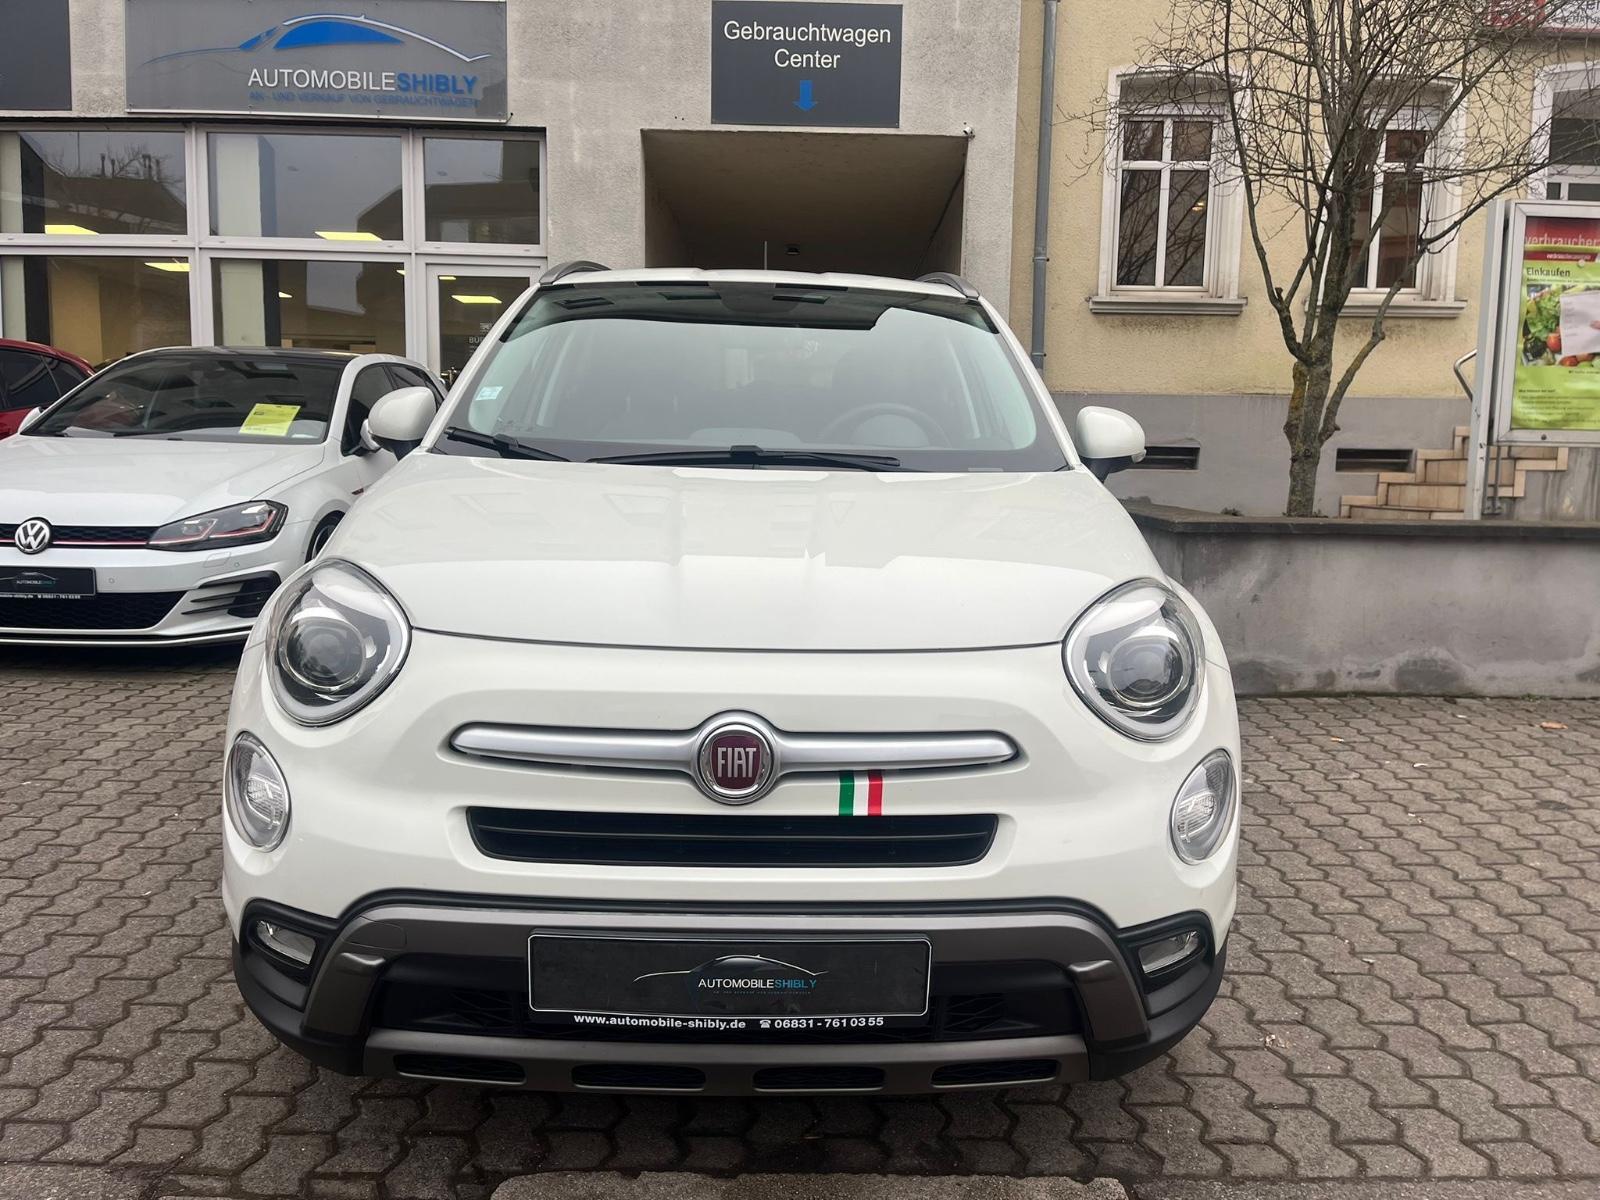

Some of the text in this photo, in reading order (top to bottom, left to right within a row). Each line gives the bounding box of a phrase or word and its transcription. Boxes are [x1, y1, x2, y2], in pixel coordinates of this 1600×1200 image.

[723, 20, 892, 47] Gebrauchtwagen
[774, 48, 841, 68] Center
[247, 68, 479, 95] AUTOMOBILESHIBLY
[1526, 267, 1571, 277] Einkaufen
[717, 747, 757, 778] FIAT
[698, 978, 817, 989] AUTOMOBILESHIBLY
[574, 1014, 746, 1030] www.automobile-shibly.de
[774, 1019, 814, 1029] 06831
